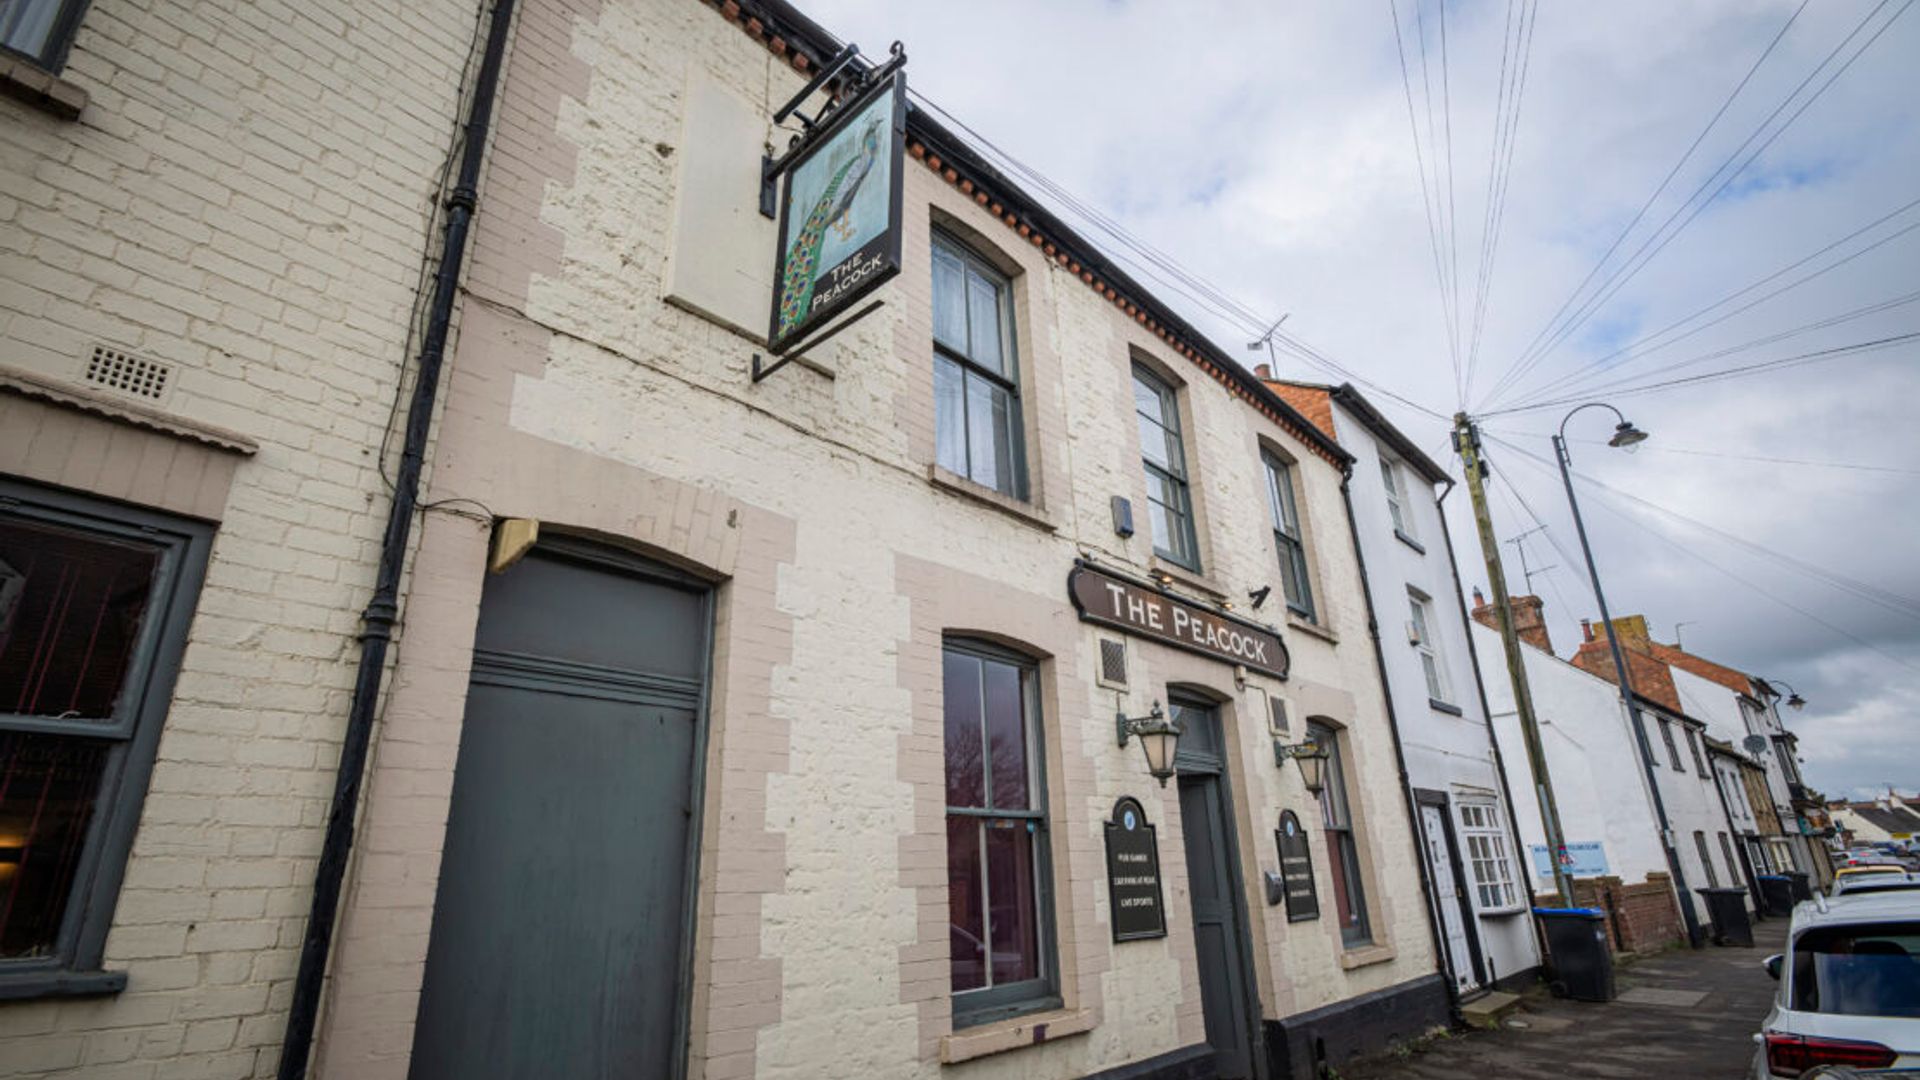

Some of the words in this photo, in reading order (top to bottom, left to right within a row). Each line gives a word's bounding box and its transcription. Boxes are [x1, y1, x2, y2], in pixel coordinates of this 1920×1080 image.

[812, 253, 883, 311] PEACOCK
[830, 252, 864, 282] THE
[1105, 582, 1164, 630] THE
[1172, 606, 1268, 665] PEACOCK
[1133, 897, 1153, 906] SPORTS
